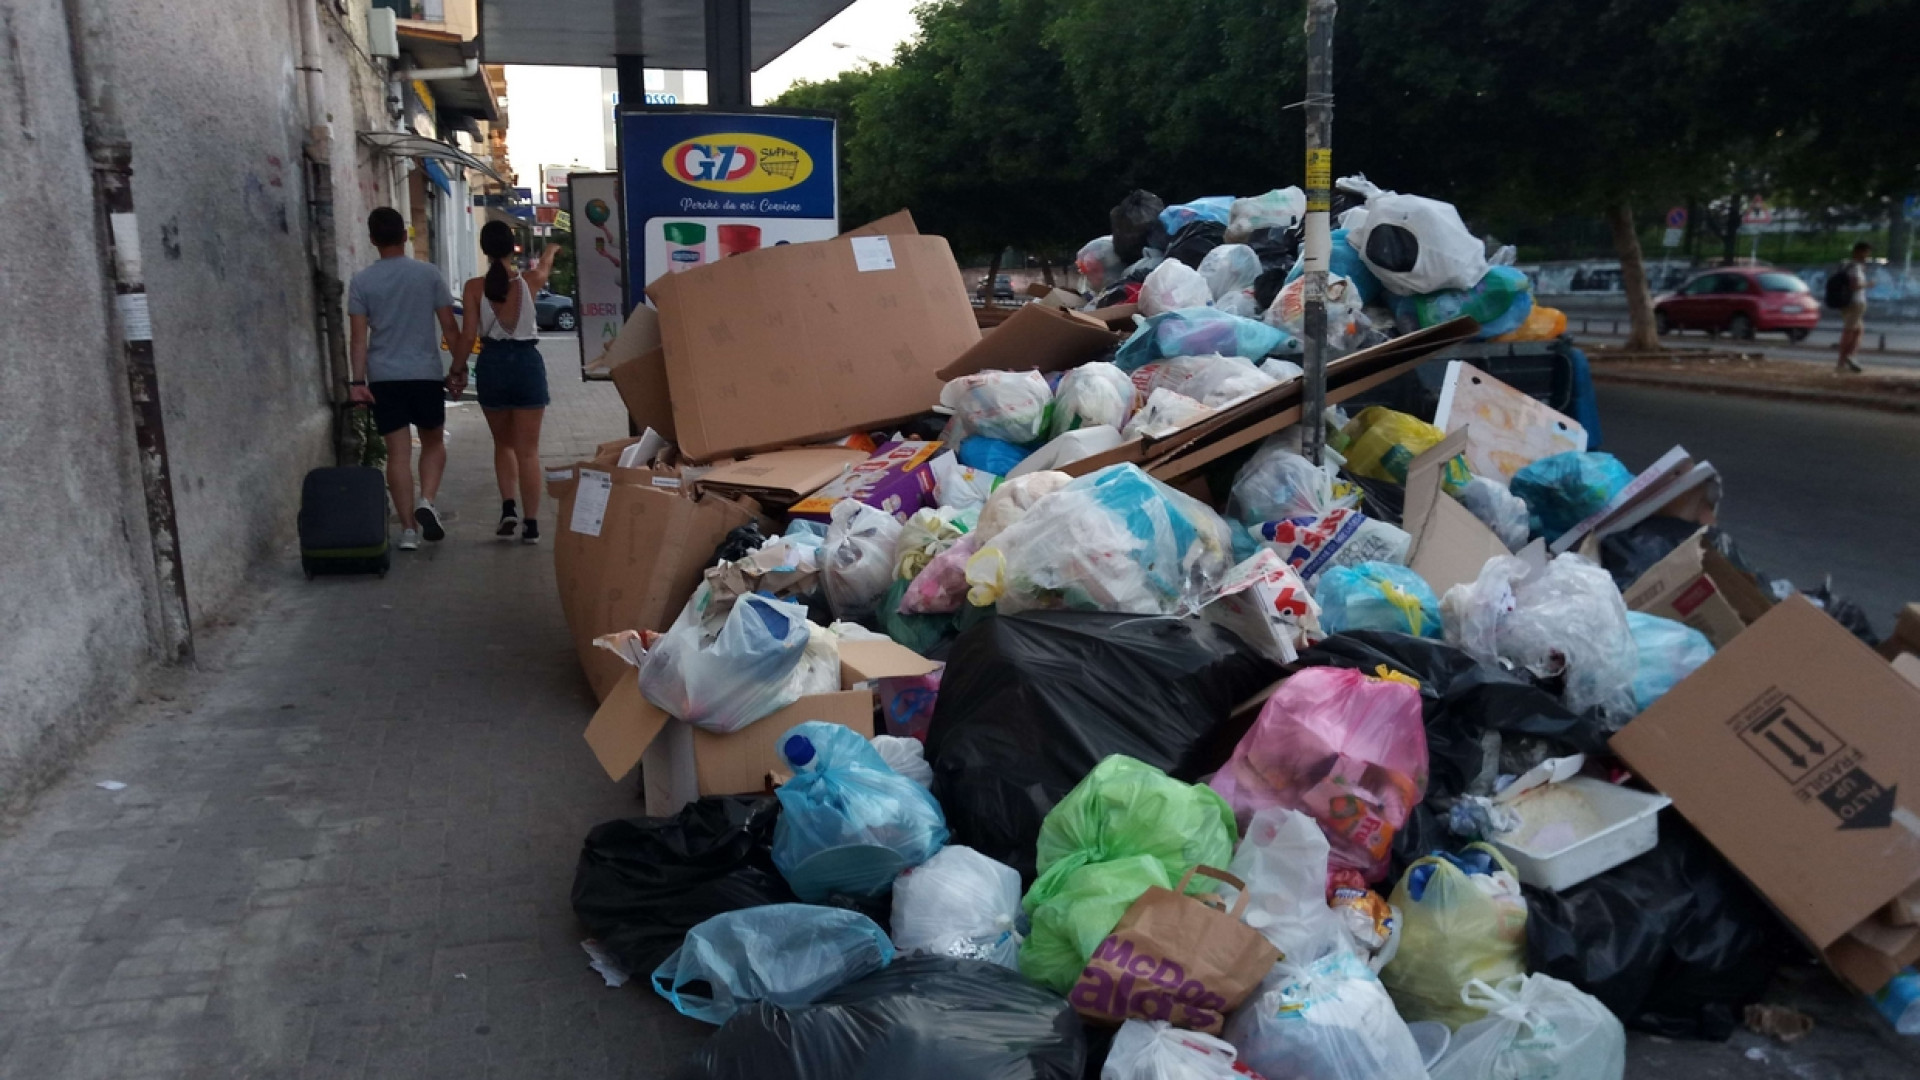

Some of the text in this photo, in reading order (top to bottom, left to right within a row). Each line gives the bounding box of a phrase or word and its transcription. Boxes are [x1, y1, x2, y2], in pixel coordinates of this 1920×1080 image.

[1794, 748, 1865, 803] FRAGILE
[1835, 778, 1857, 798] UP
[1840, 785, 1880, 819] ALTO
